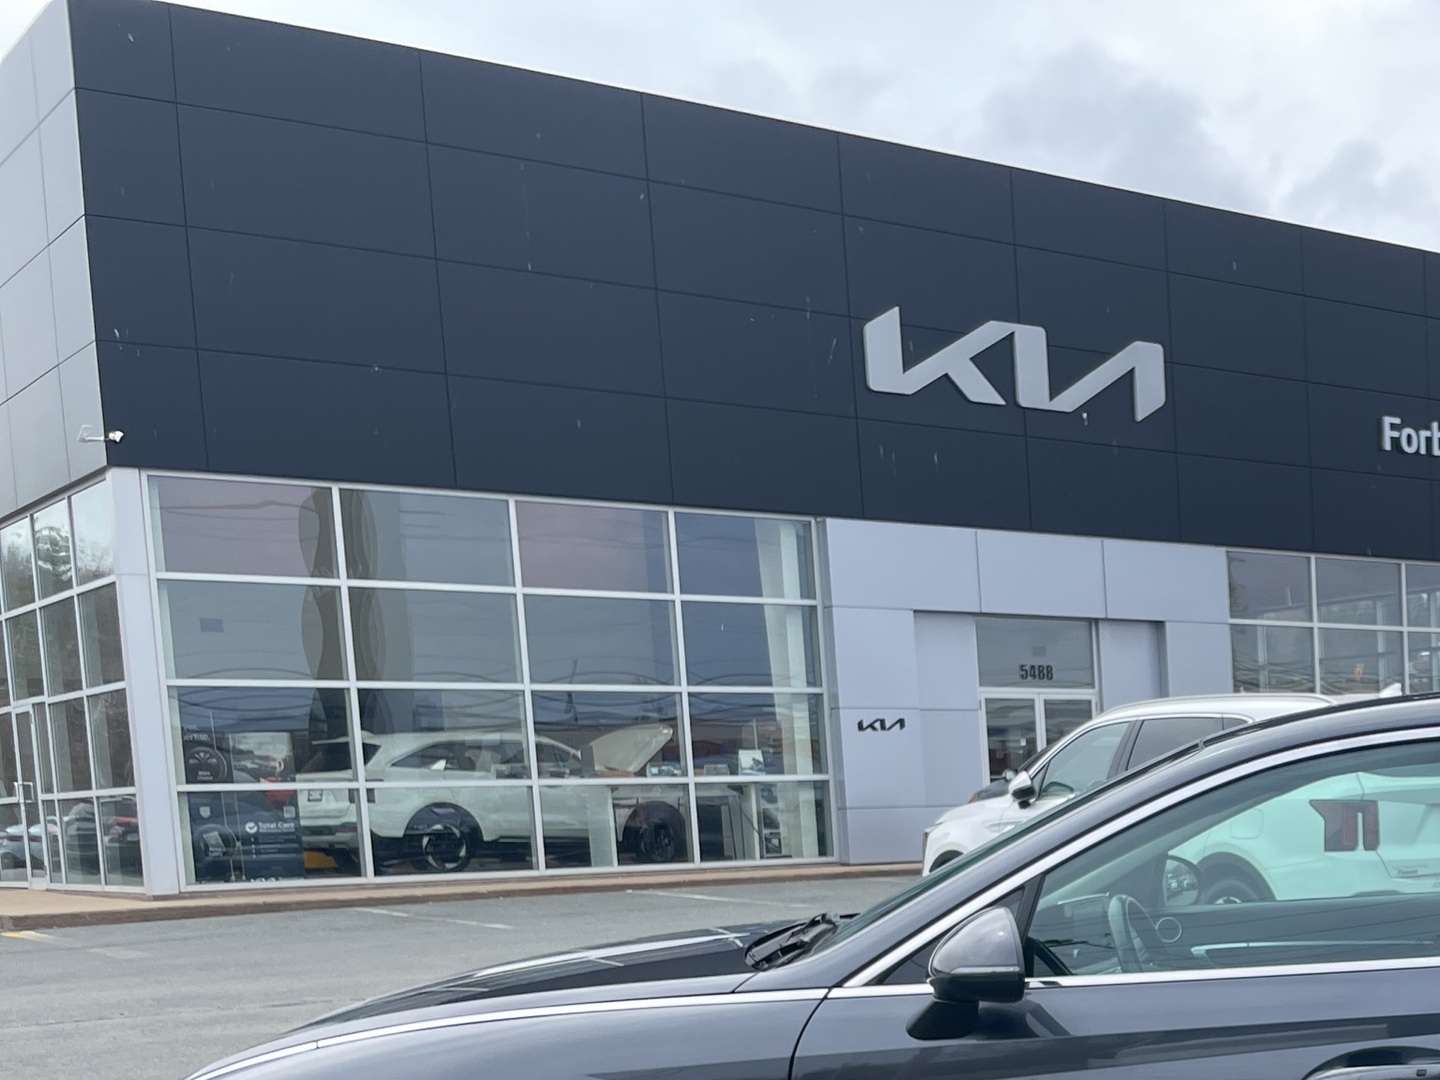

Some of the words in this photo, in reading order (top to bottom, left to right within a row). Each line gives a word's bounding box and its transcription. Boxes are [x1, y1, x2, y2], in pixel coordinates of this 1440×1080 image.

[863, 306, 1166, 422] KIA
[1019, 664, 1054, 680] 5488
[857, 718, 906, 732] KIA
